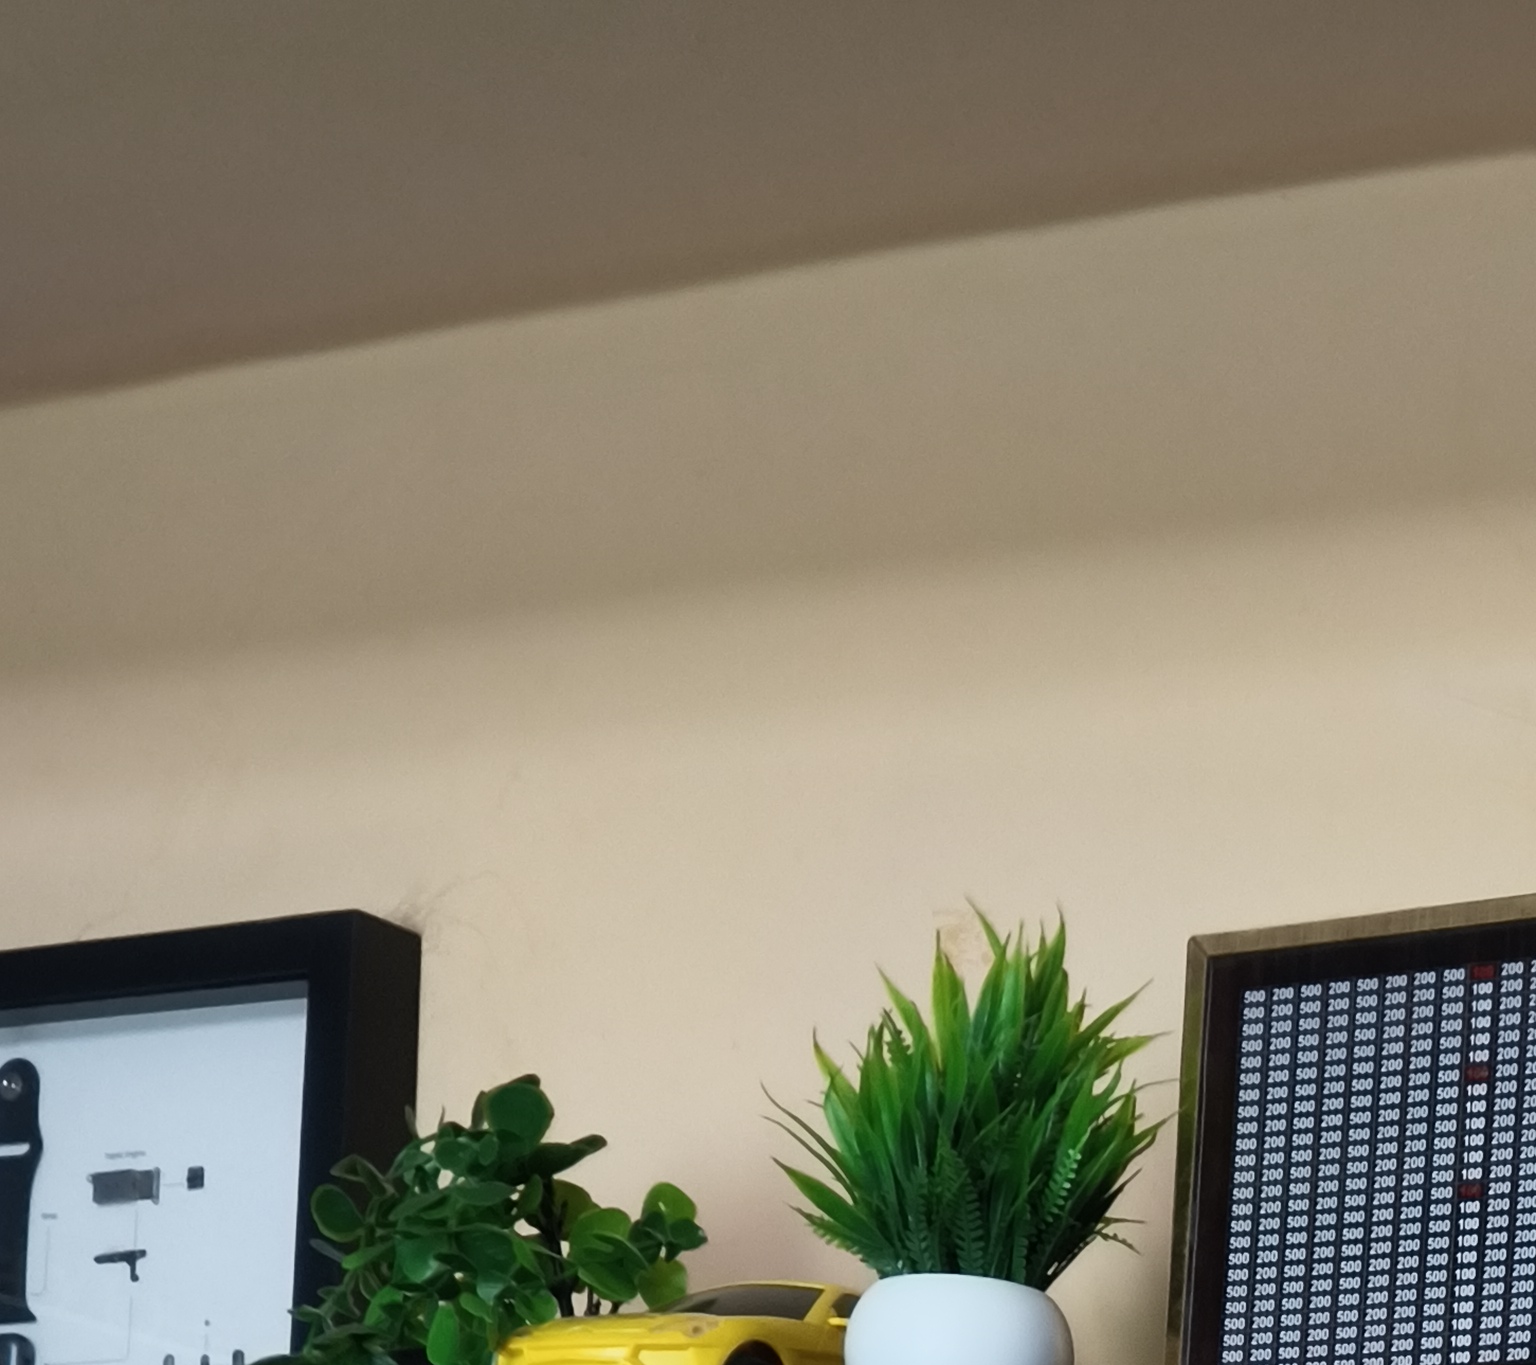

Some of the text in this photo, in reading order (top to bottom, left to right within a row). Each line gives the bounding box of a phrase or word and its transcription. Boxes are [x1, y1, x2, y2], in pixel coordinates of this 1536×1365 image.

[1243, 989, 1266, 1004] 500
[1272, 986, 1294, 1001] 200
[1300, 983, 1322, 998] 500
[1328, 980, 1351, 995] 200
[1356, 977, 1379, 992] 500
[1385, 974, 1408, 989] 200
[1413, 971, 1436, 986] 200
[1443, 968, 1466, 983] 500
[1501, 961, 1524, 976] 200
[1243, 1006, 1265, 1020] 500
[1271, 1003, 1293, 1018] 200
[1299, 1000, 1321, 1015] 500
[1327, 997, 1350, 1012] 200
[1355, 994, 1378, 1009] 500
[1384, 990, 1407, 1006] 200
[1412, 988, 1435, 1003] 200
[1442, 984, 1465, 1000] 500
[1472, 981, 1493, 995] 100
[1500, 978, 1523, 993] 200
[1241, 1039, 1263, 1053] 500
[1269, 1036, 1292, 1051] 200
[1297, 1033, 1320, 1048] 500
[1325, 1030, 1348, 1045] 200
[1354, 1027, 1376, 1042] 500
[1382, 1024, 1405, 1039] 200
[1410, 1021, 1434, 1036] 200
[1440, 1018, 1463, 1033] 500
[1470, 1015, 1491, 1029] 100
[1498, 1011, 1521, 1027] 200
[1242, 1022, 1264, 1037] 500
[1270, 1019, 1292, 1034] 200
[1298, 1017, 1321, 1031] 500
[1326, 1014, 1349, 1028] 200
[1355, 1010, 1377, 1025] 500
[1383, 1007, 1406, 1022] 200
[1412, 1004, 1434, 1019] 200
[1441, 1001, 1464, 1016] 500
[1471, 998, 1493, 1012] 100
[1499, 995, 1522, 1010] 200
[1234, 1153, 1256, 1168] 500
[1262, 1151, 1285, 1166] 200
[1290, 1149, 1313, 1163] 500
[1318, 1146, 1341, 1161] 200
[1347, 1144, 1370, 1158] 500
[1375, 1141, 1398, 1156] 200
[1404, 1138, 1427, 1153] 200
[1433, 1135, 1456, 1150] 500
[1464, 1133, 1485, 1147] 100
[1491, 1130, 1515, 1145] 200
[1228, 1252, 1250, 1266] 500
[1256, 1250, 1279, 1264] 200
[1284, 1247, 1307, 1261] 500
[1312, 1245, 1335, 1259] 200
[1340, 1243, 1363, 1257] 500
[1369, 1241, 1392, 1255] 200
[1397, 1238, 1421, 1253] 200
[1427, 1236, 1450, 1250] 500
[1457, 1234, 1479, 1247] 100
[1484, 1231, 1508, 1246] 200
[1449, 1350, 1471, 1364] 100
[1477, 1348, 1501, 1363] 200
[1506, 1347, 1530, 1361] 200
